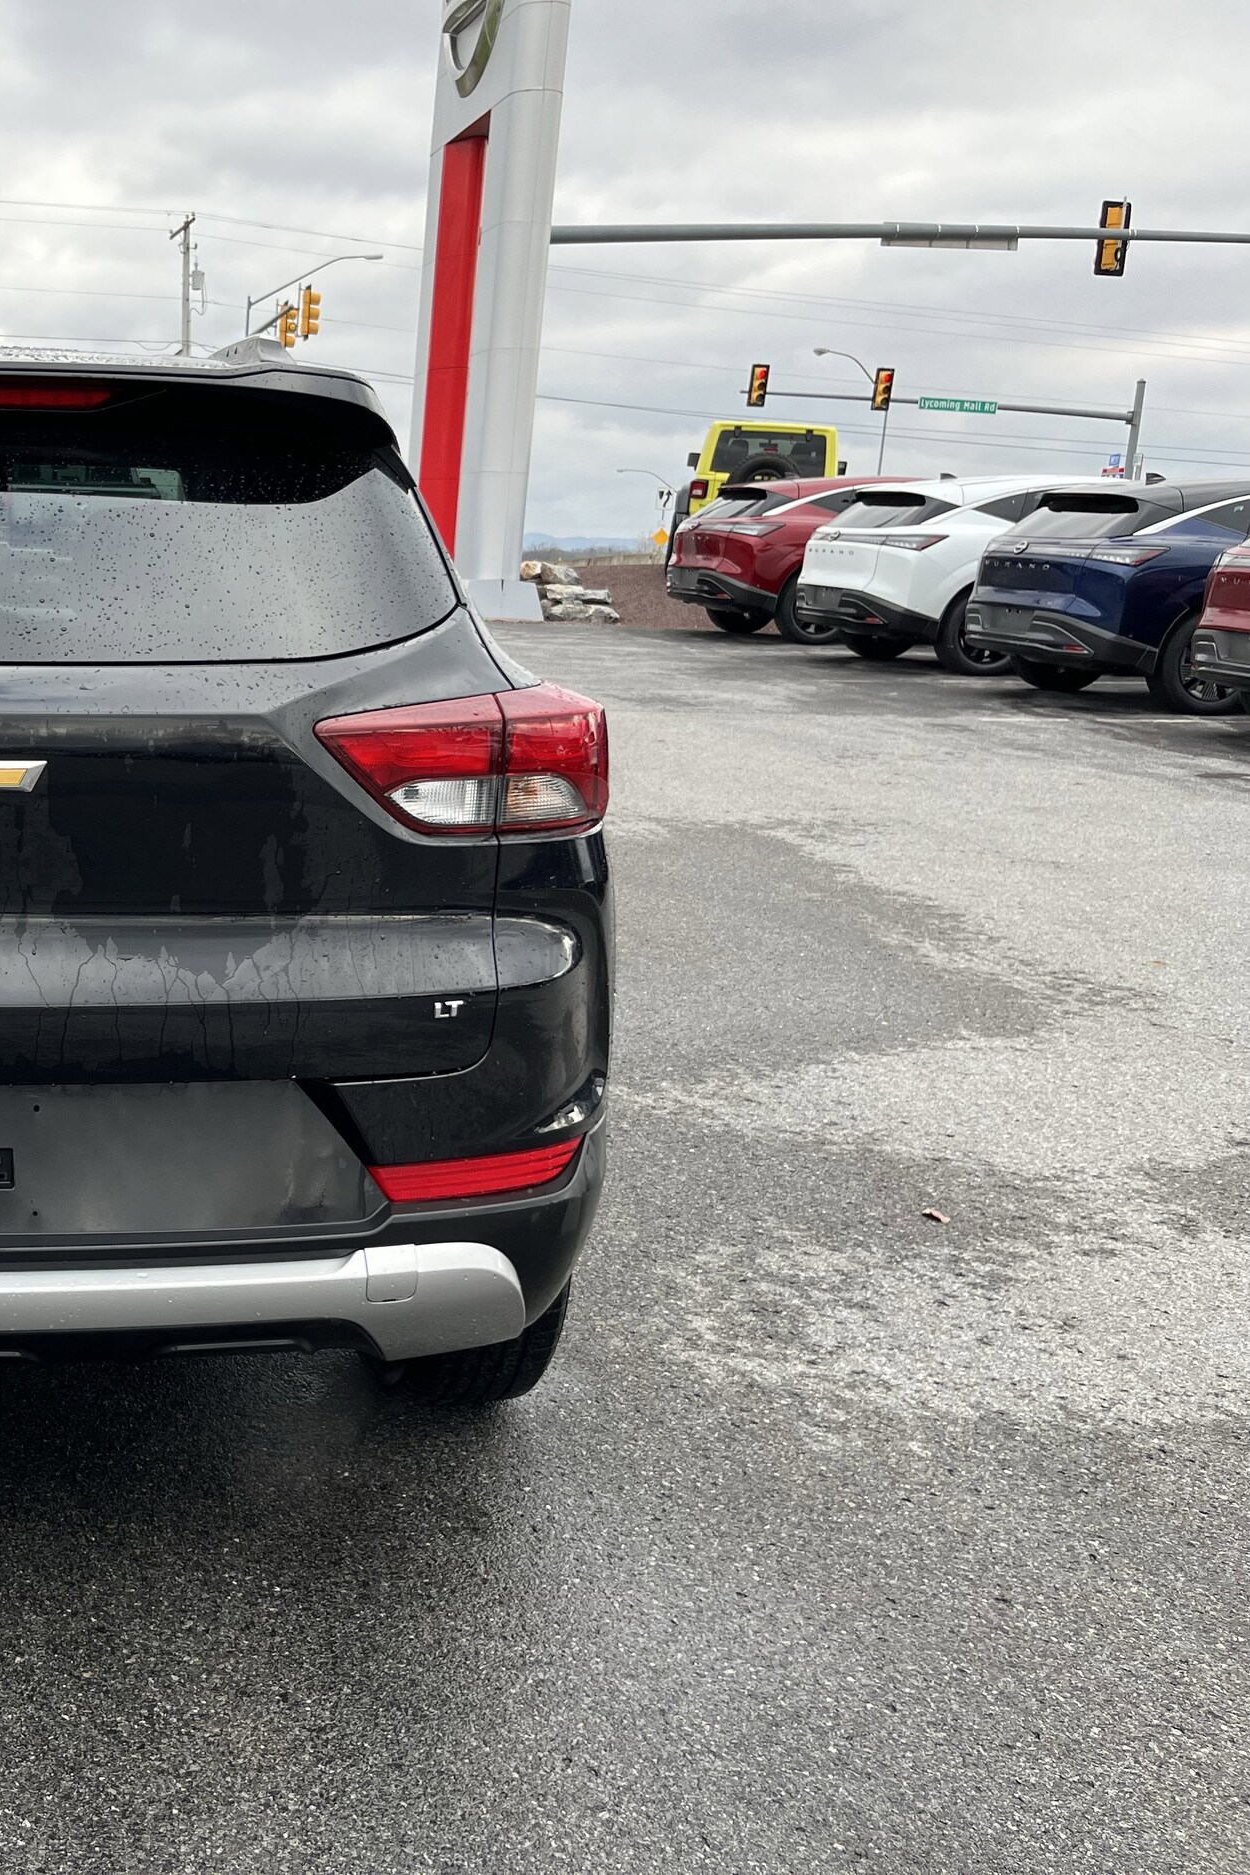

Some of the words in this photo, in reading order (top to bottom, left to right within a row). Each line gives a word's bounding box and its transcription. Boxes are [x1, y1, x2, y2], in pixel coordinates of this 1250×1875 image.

[920, 398, 960, 411] Lycoming
[963, 402, 981, 412] Mall
[984, 402, 995, 412] Rd
[434, 1000, 464, 1019] LT
